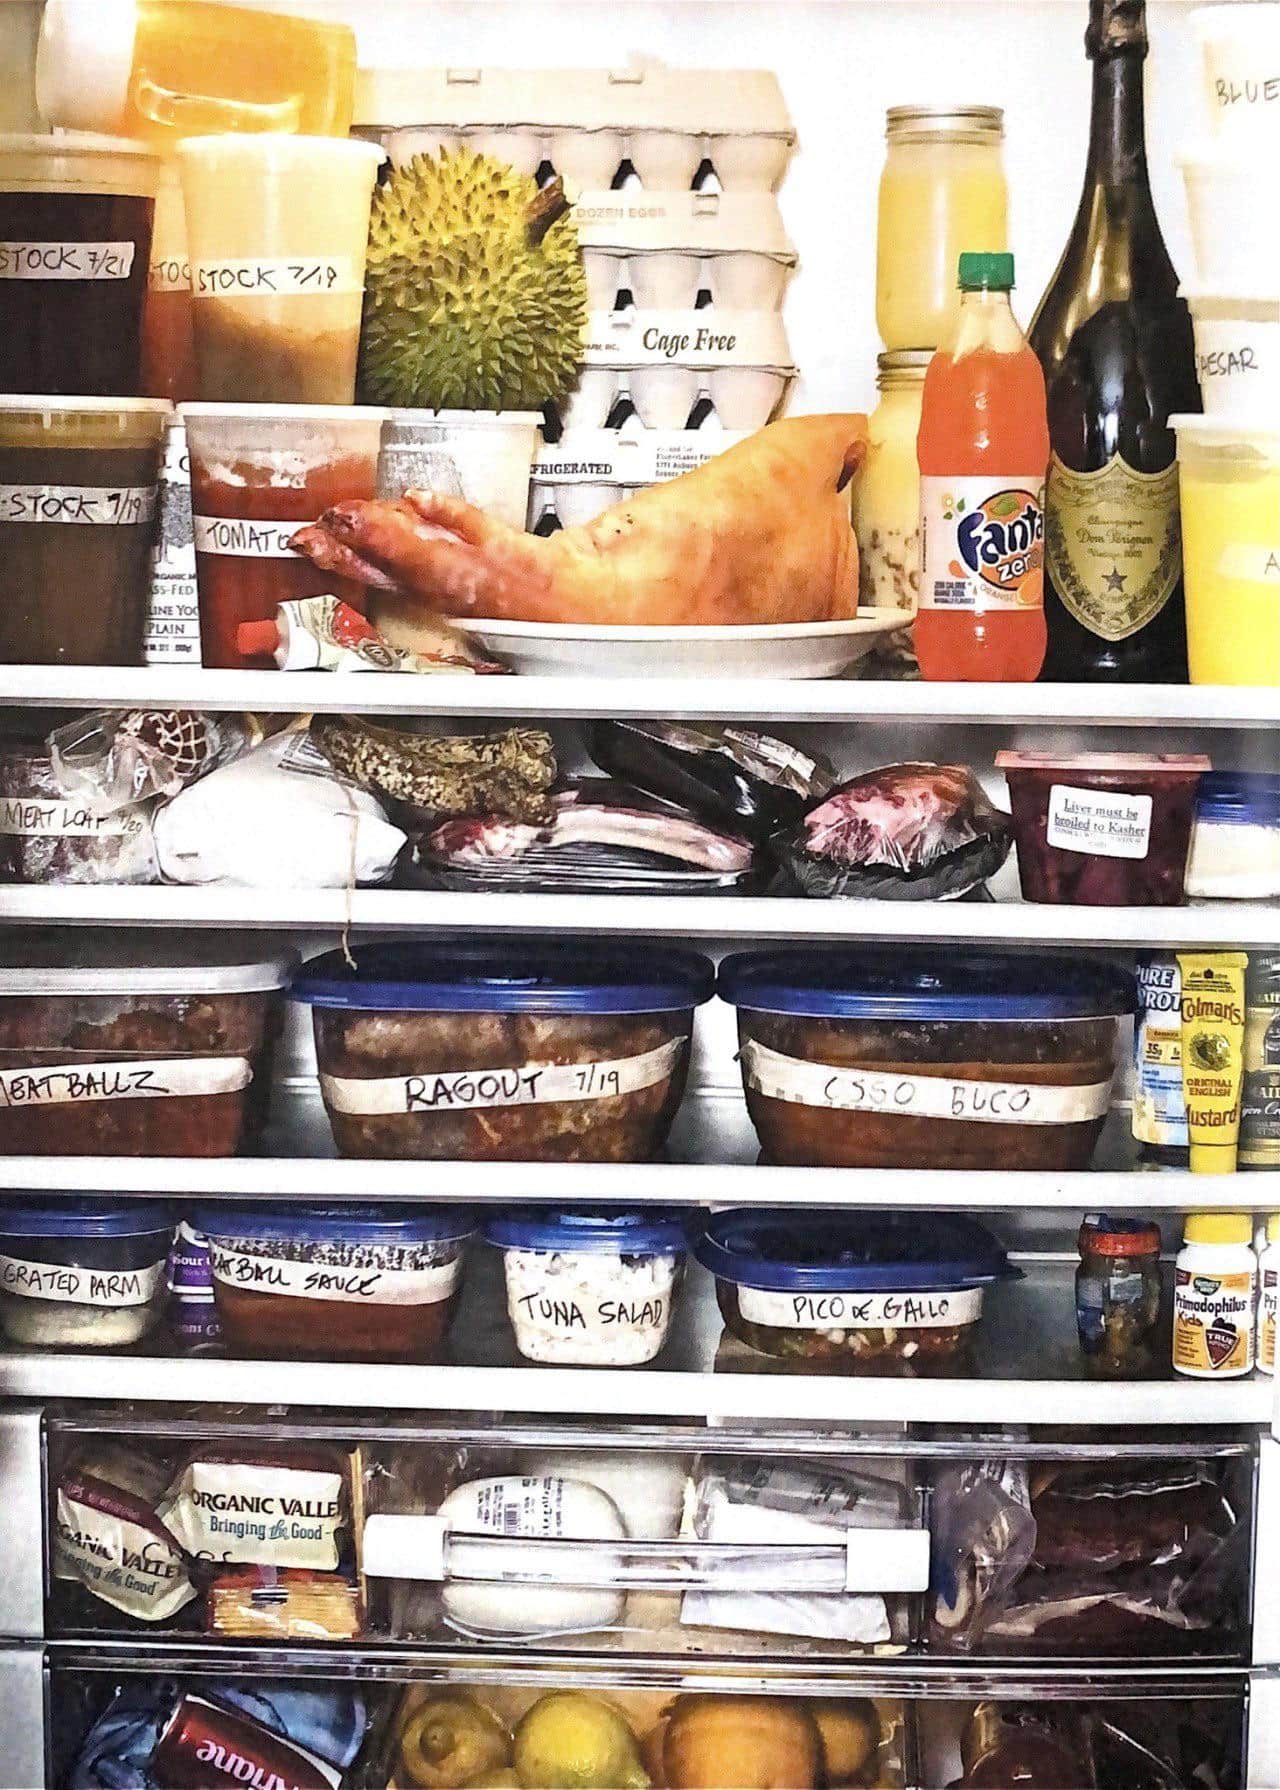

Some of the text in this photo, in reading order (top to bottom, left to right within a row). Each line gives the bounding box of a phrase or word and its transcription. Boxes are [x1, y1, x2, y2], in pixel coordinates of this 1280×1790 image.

[1216, 78, 1280, 105] BLUE
[88, 249, 124, 275] 7/21
[199, 267, 276, 292] STOCK
[643, 328, 736, 358] Cage Free
[9, 490, 142, 525] STOCK 7/19
[5, 802, 56, 828] MEAT
[1054, 812, 1090, 830] broiled
[1094, 822, 1105, 831] to
[1064, 798, 1138, 819] Liver must be
[405, 1064, 619, 1112] RAGOUT 7/19
[952, 1086, 1030, 1115] BUCO
[1189, 1087, 1231, 1097] ENGLISH
[3, 1264, 141, 1299] GRATED PARM
[304, 1272, 382, 1296] SAUCE
[518, 1292, 662, 1329] TUNA SALAD
[793, 1296, 845, 1322] PICO
[191, 1489, 275, 1514] ORGANIC
[210, 1516, 266, 1541] Bringing
[291, 1523, 323, 1540] Good
